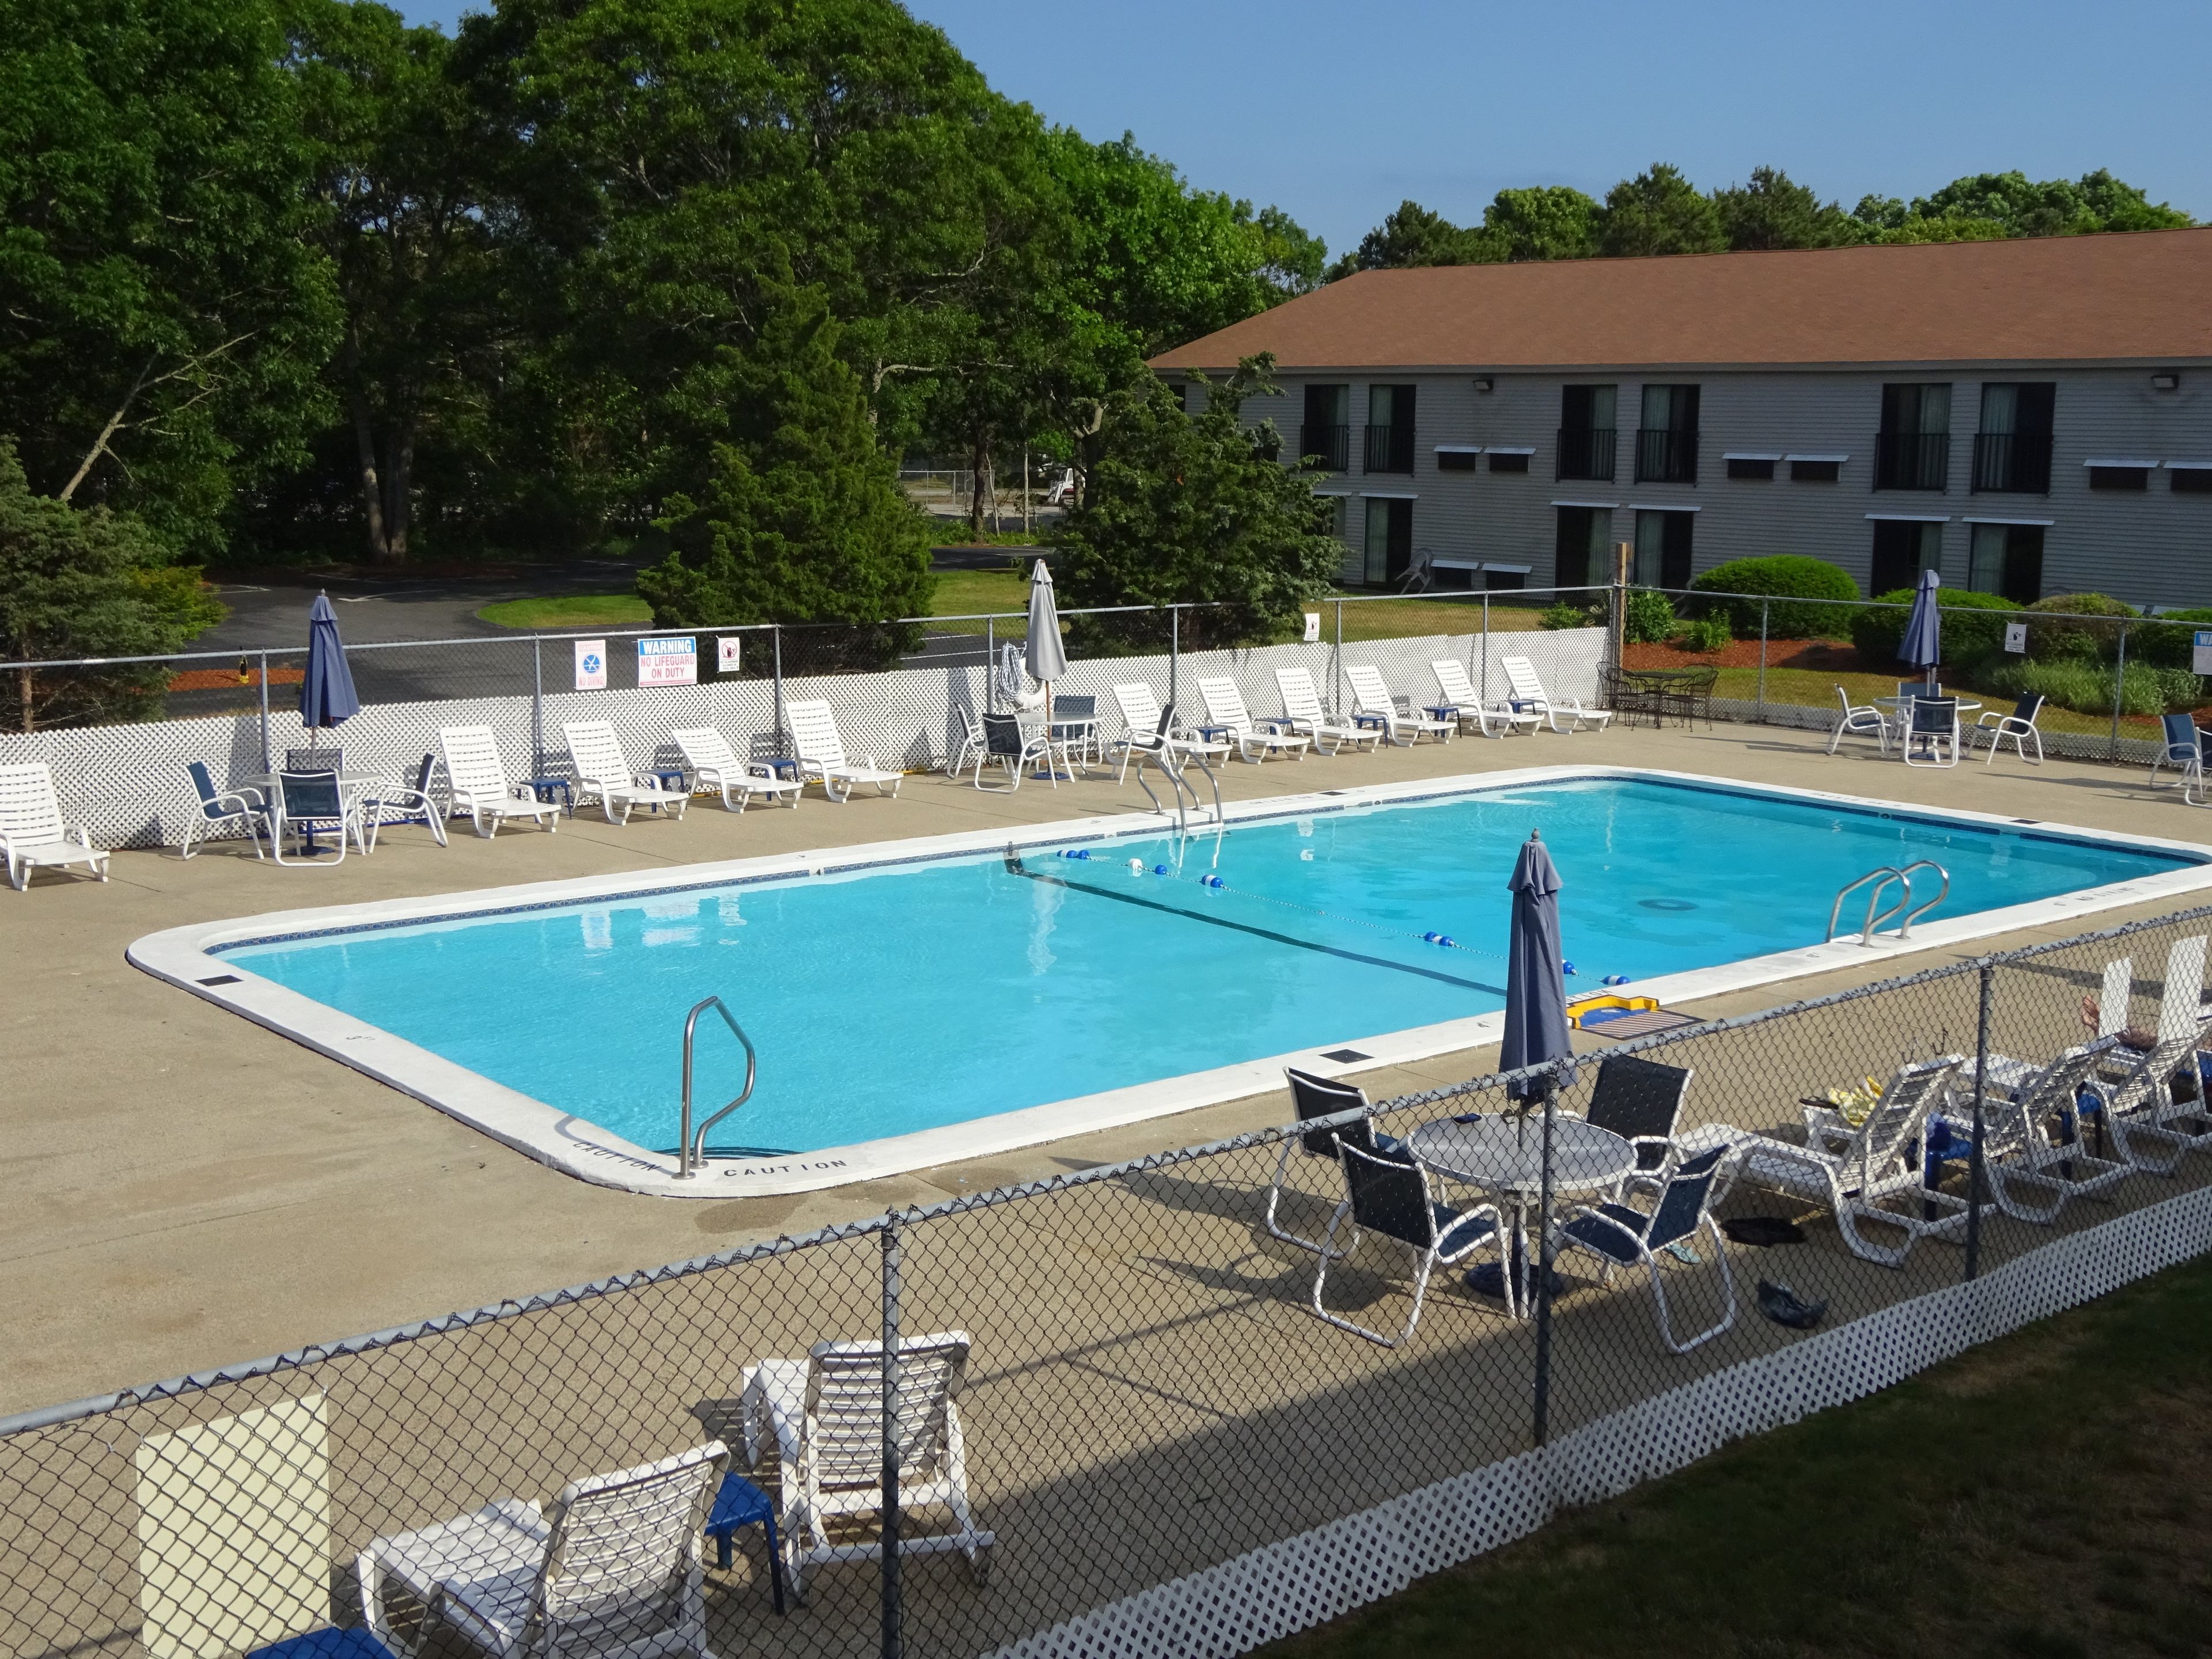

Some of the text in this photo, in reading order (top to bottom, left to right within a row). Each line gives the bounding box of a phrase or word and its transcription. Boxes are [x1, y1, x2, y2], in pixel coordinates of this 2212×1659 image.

[642, 639, 692, 655] WARNING
[641, 655, 695, 667] NO LIFEGUARD
[652, 667, 684, 679] ON DUTY
[579, 677, 586, 687] NO
[573, 1142, 662, 1171] CAUTION
[724, 1160, 847, 1177] CAUTION
